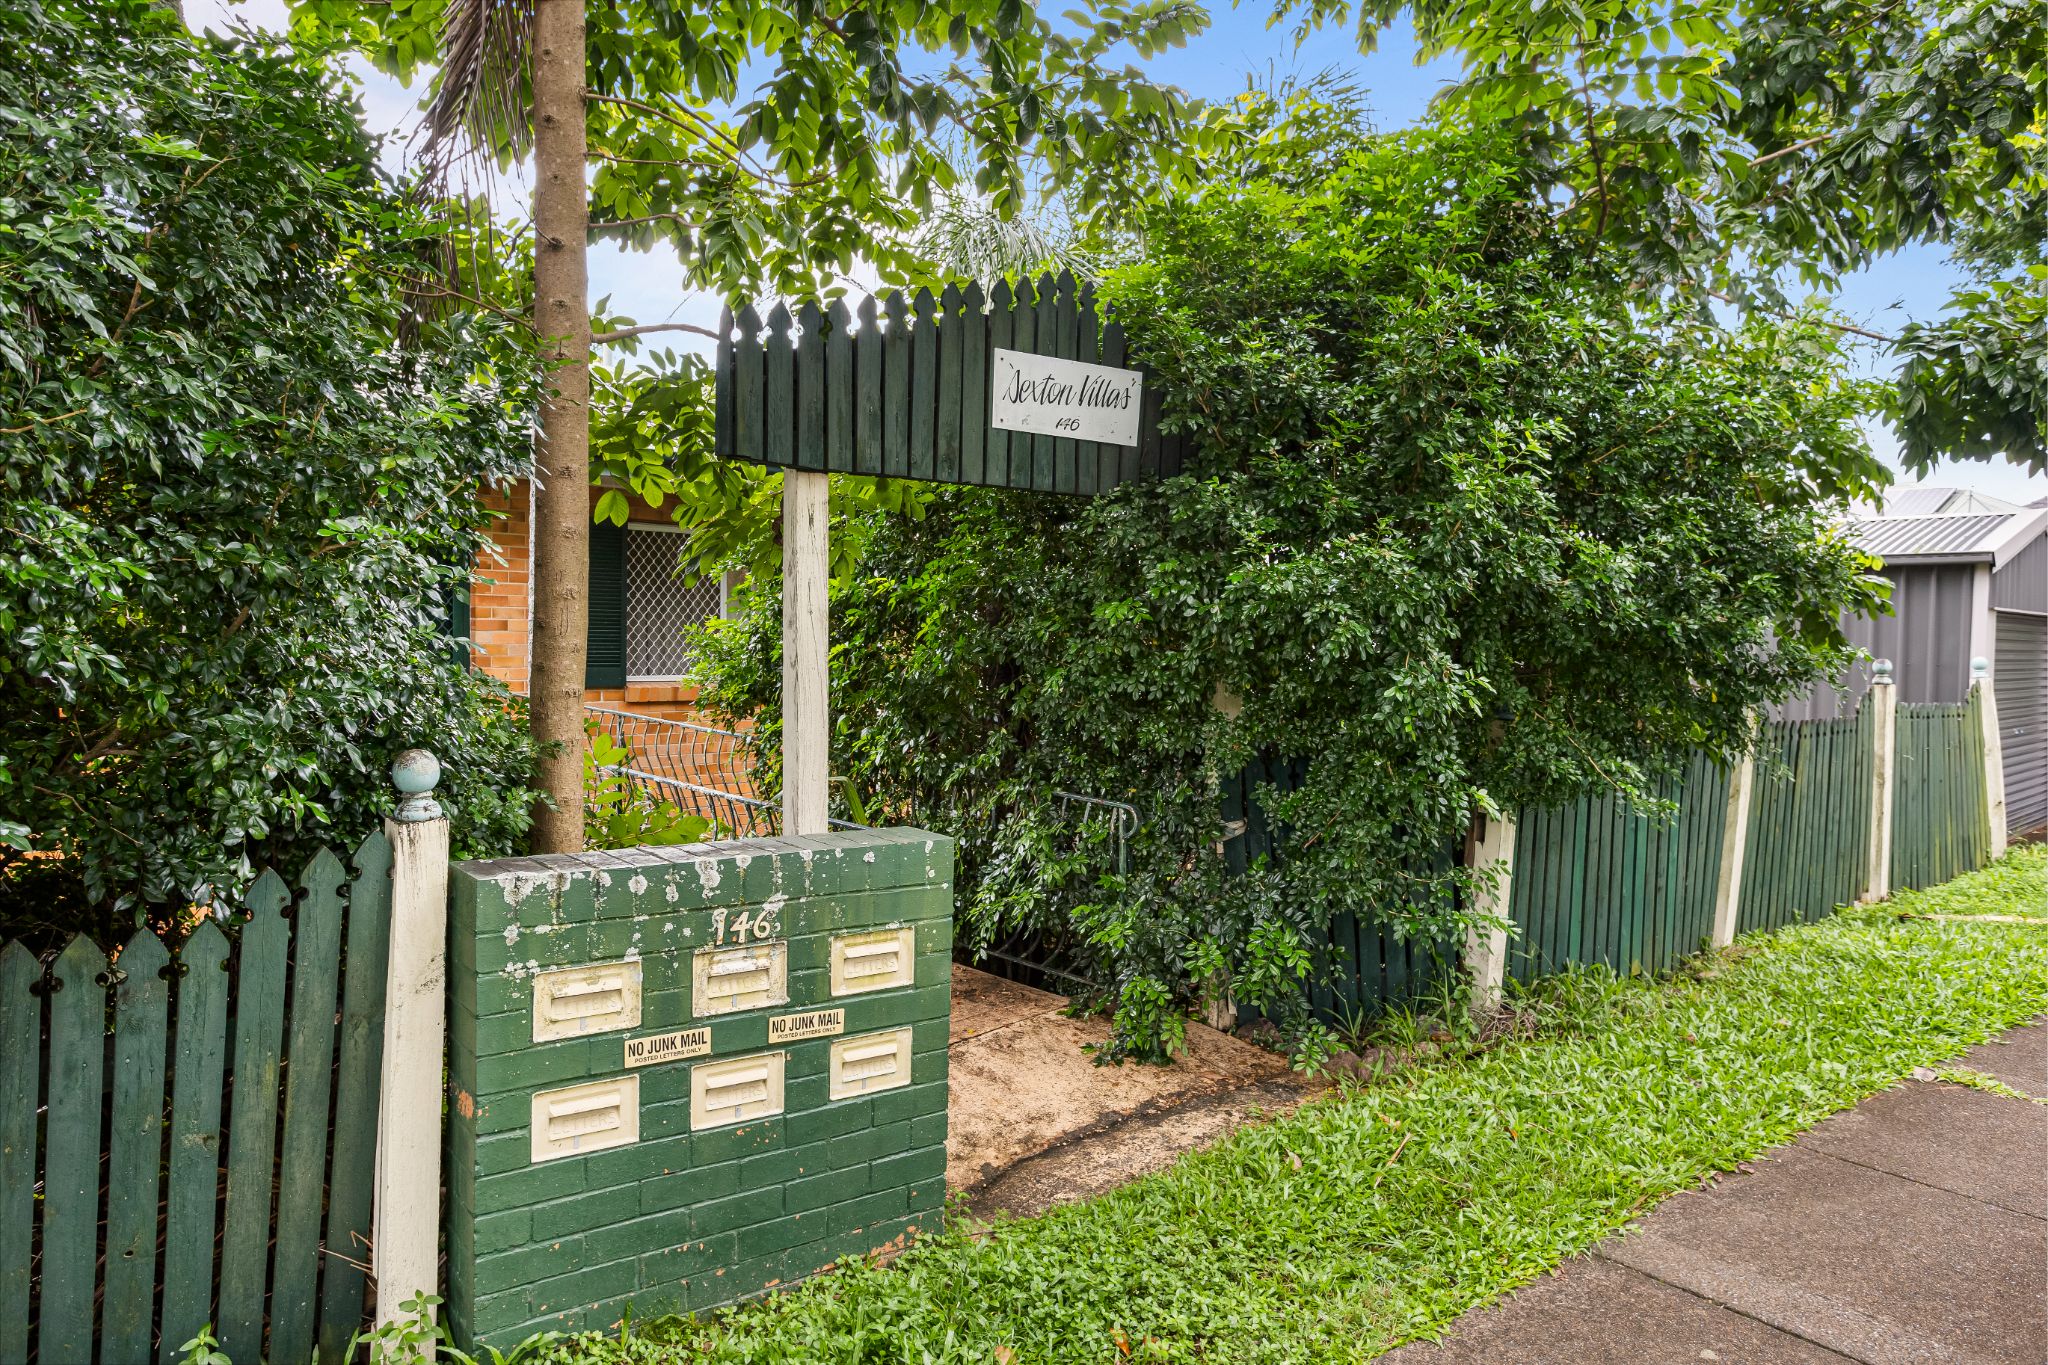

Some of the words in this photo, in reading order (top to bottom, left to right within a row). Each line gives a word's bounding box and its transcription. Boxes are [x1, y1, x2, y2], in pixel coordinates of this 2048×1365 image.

[1055, 417, 1081, 432] 146
[712, 907, 774, 946] 146
[771, 1019, 787, 1034] NO
[788, 1014, 816, 1031] JUNK
[817, 1011, 842, 1027] MAIL
[777, 1031, 799, 1040] POSTED
[799, 1028, 822, 1037] LETTERS
[822, 1026, 836, 1034] ONLY
[628, 1041, 644, 1058] NO
[647, 1034, 678, 1054] JUNK
[680, 1030, 708, 1048] MAIL
[634, 1053, 659, 1064] POSTED
[659, 1050, 685, 1060] LETTERS
[686, 1047, 702, 1055] ONLY
